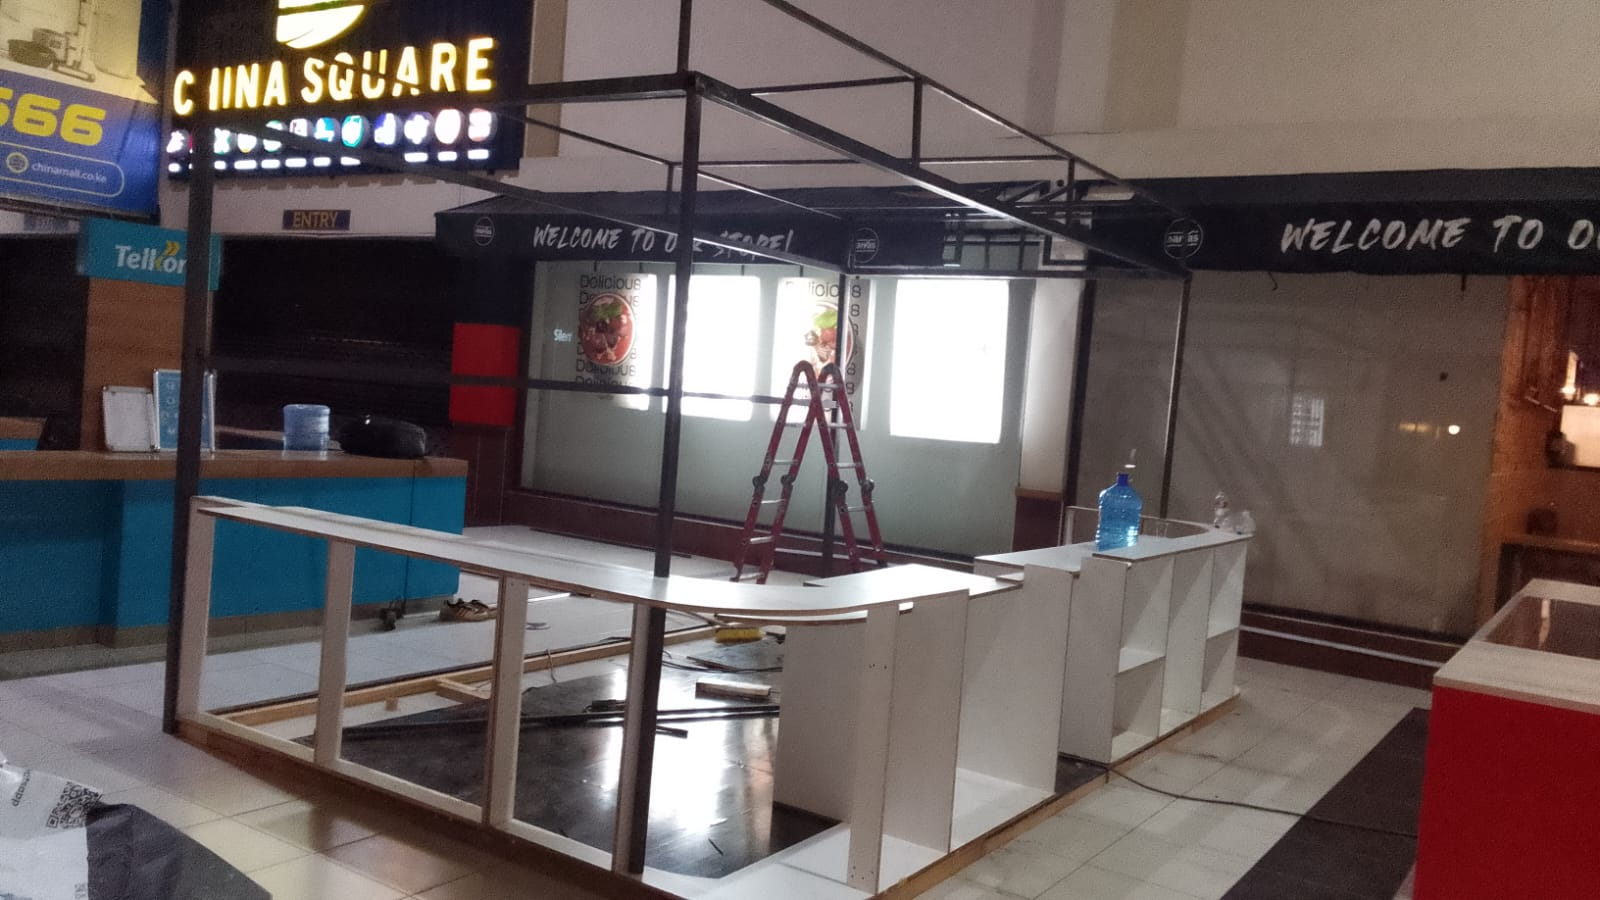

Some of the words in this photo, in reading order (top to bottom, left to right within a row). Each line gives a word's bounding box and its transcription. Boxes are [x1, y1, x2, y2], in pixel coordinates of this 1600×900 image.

[301, 37, 494, 103] SQUARE
[0, 86, 107, 147] 66
[31, 161, 107, 183] chinamall.co.ke
[292, 211, 338, 229] ENTRY
[1280, 217, 1472, 254] WELCOME
[1493, 214, 1544, 253] TO
[1567, 219, 1600, 251] O
[533, 224, 623, 250] WELCOME
[631, 227, 655, 254] TO
[664, 231, 703, 253] OR
